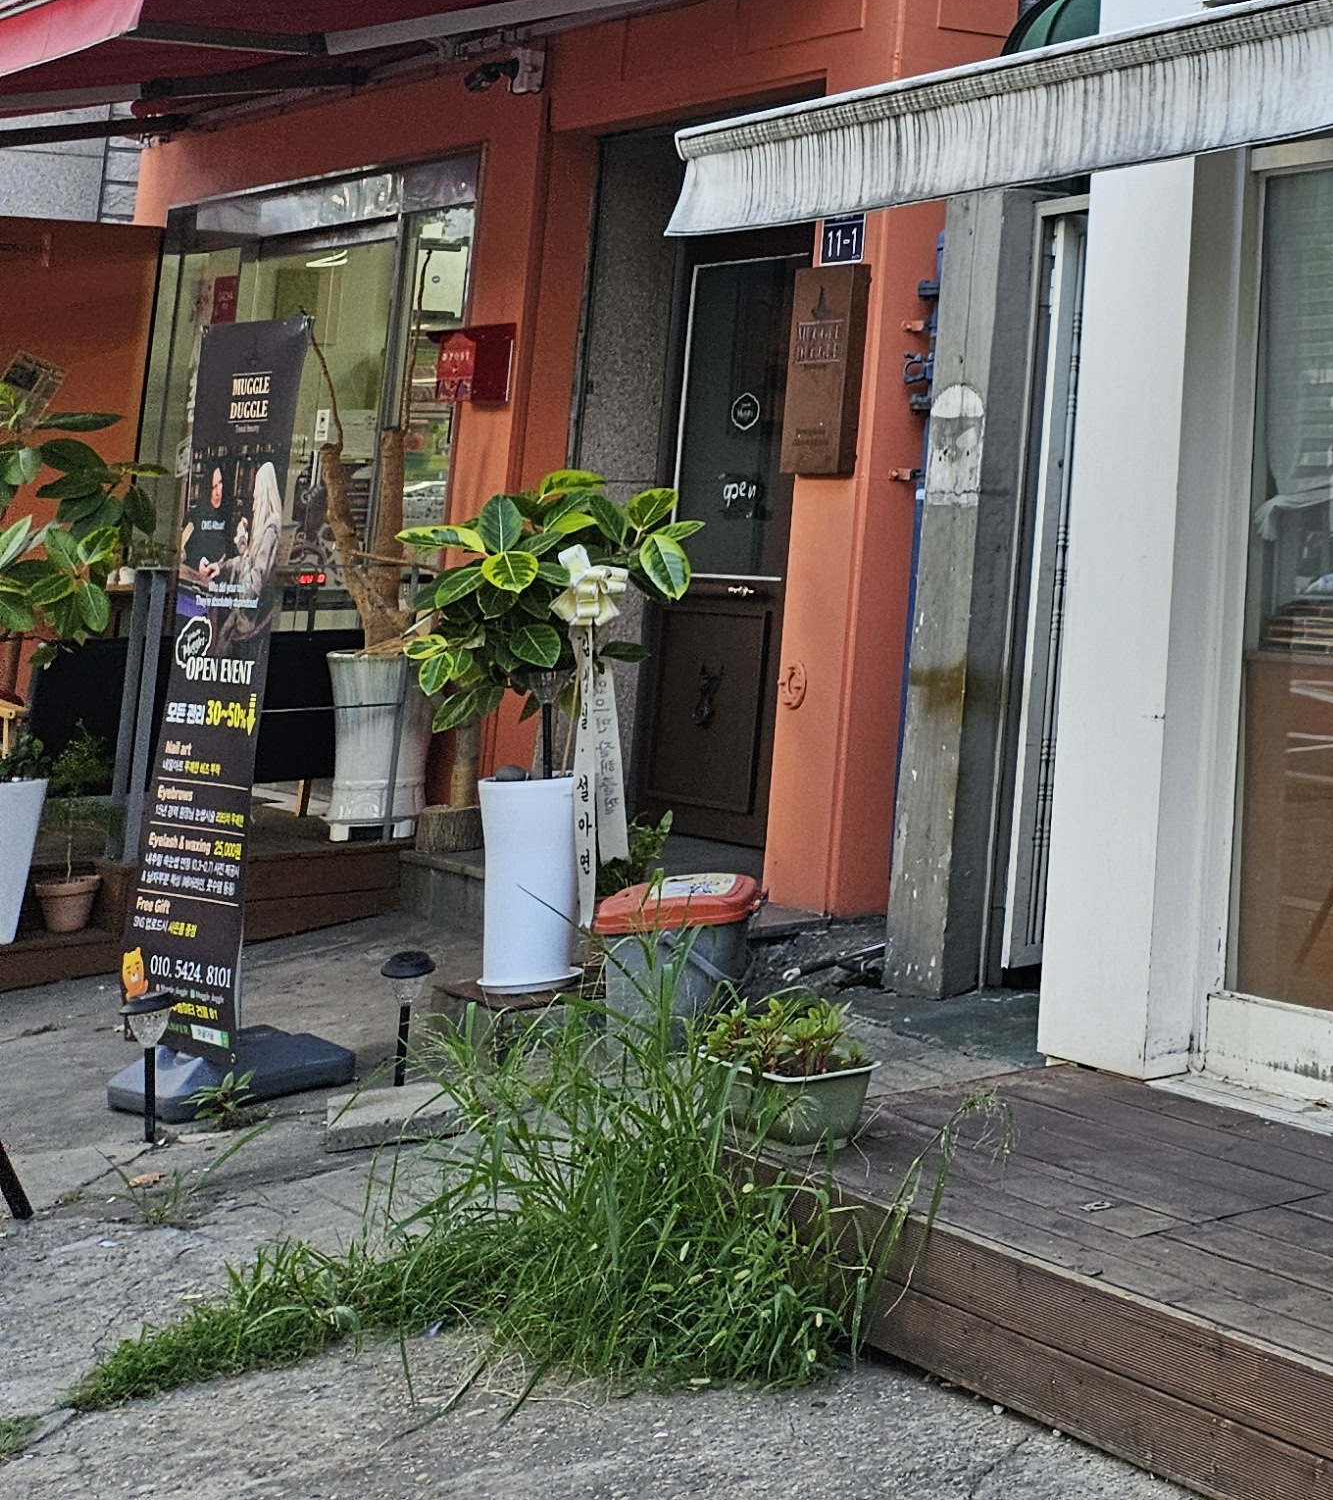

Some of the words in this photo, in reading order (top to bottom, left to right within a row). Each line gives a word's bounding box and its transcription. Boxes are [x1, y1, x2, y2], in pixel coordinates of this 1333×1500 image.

[827, 227, 857, 257] 11-1
[231, 376, 270, 396] MUGGLE
[229, 400, 269, 420] DUGGLE
[186, 656, 218, 682] OPEN
[220, 658, 255, 685] EVENT
[166, 701, 187, 724] 모든
[186, 703, 205, 726] 관리
[205, 700, 247, 729] 30~50%
[165, 740, 181, 754] Nail
[180, 742, 192, 756] art
[157, 784, 194, 802] Eyebrows
[148, 831, 178, 848] Eyelash
[178, 835, 184, 849] &
[185, 838, 211, 856] waxing
[213, 840, 242, 860] 25,000원
[136, 896, 154, 912] Free
[154, 898, 171, 915] Gift
[150, 955, 172, 978] 010.
[174, 959, 203, 984] 5424.
[206, 965, 231, 988] 8101
